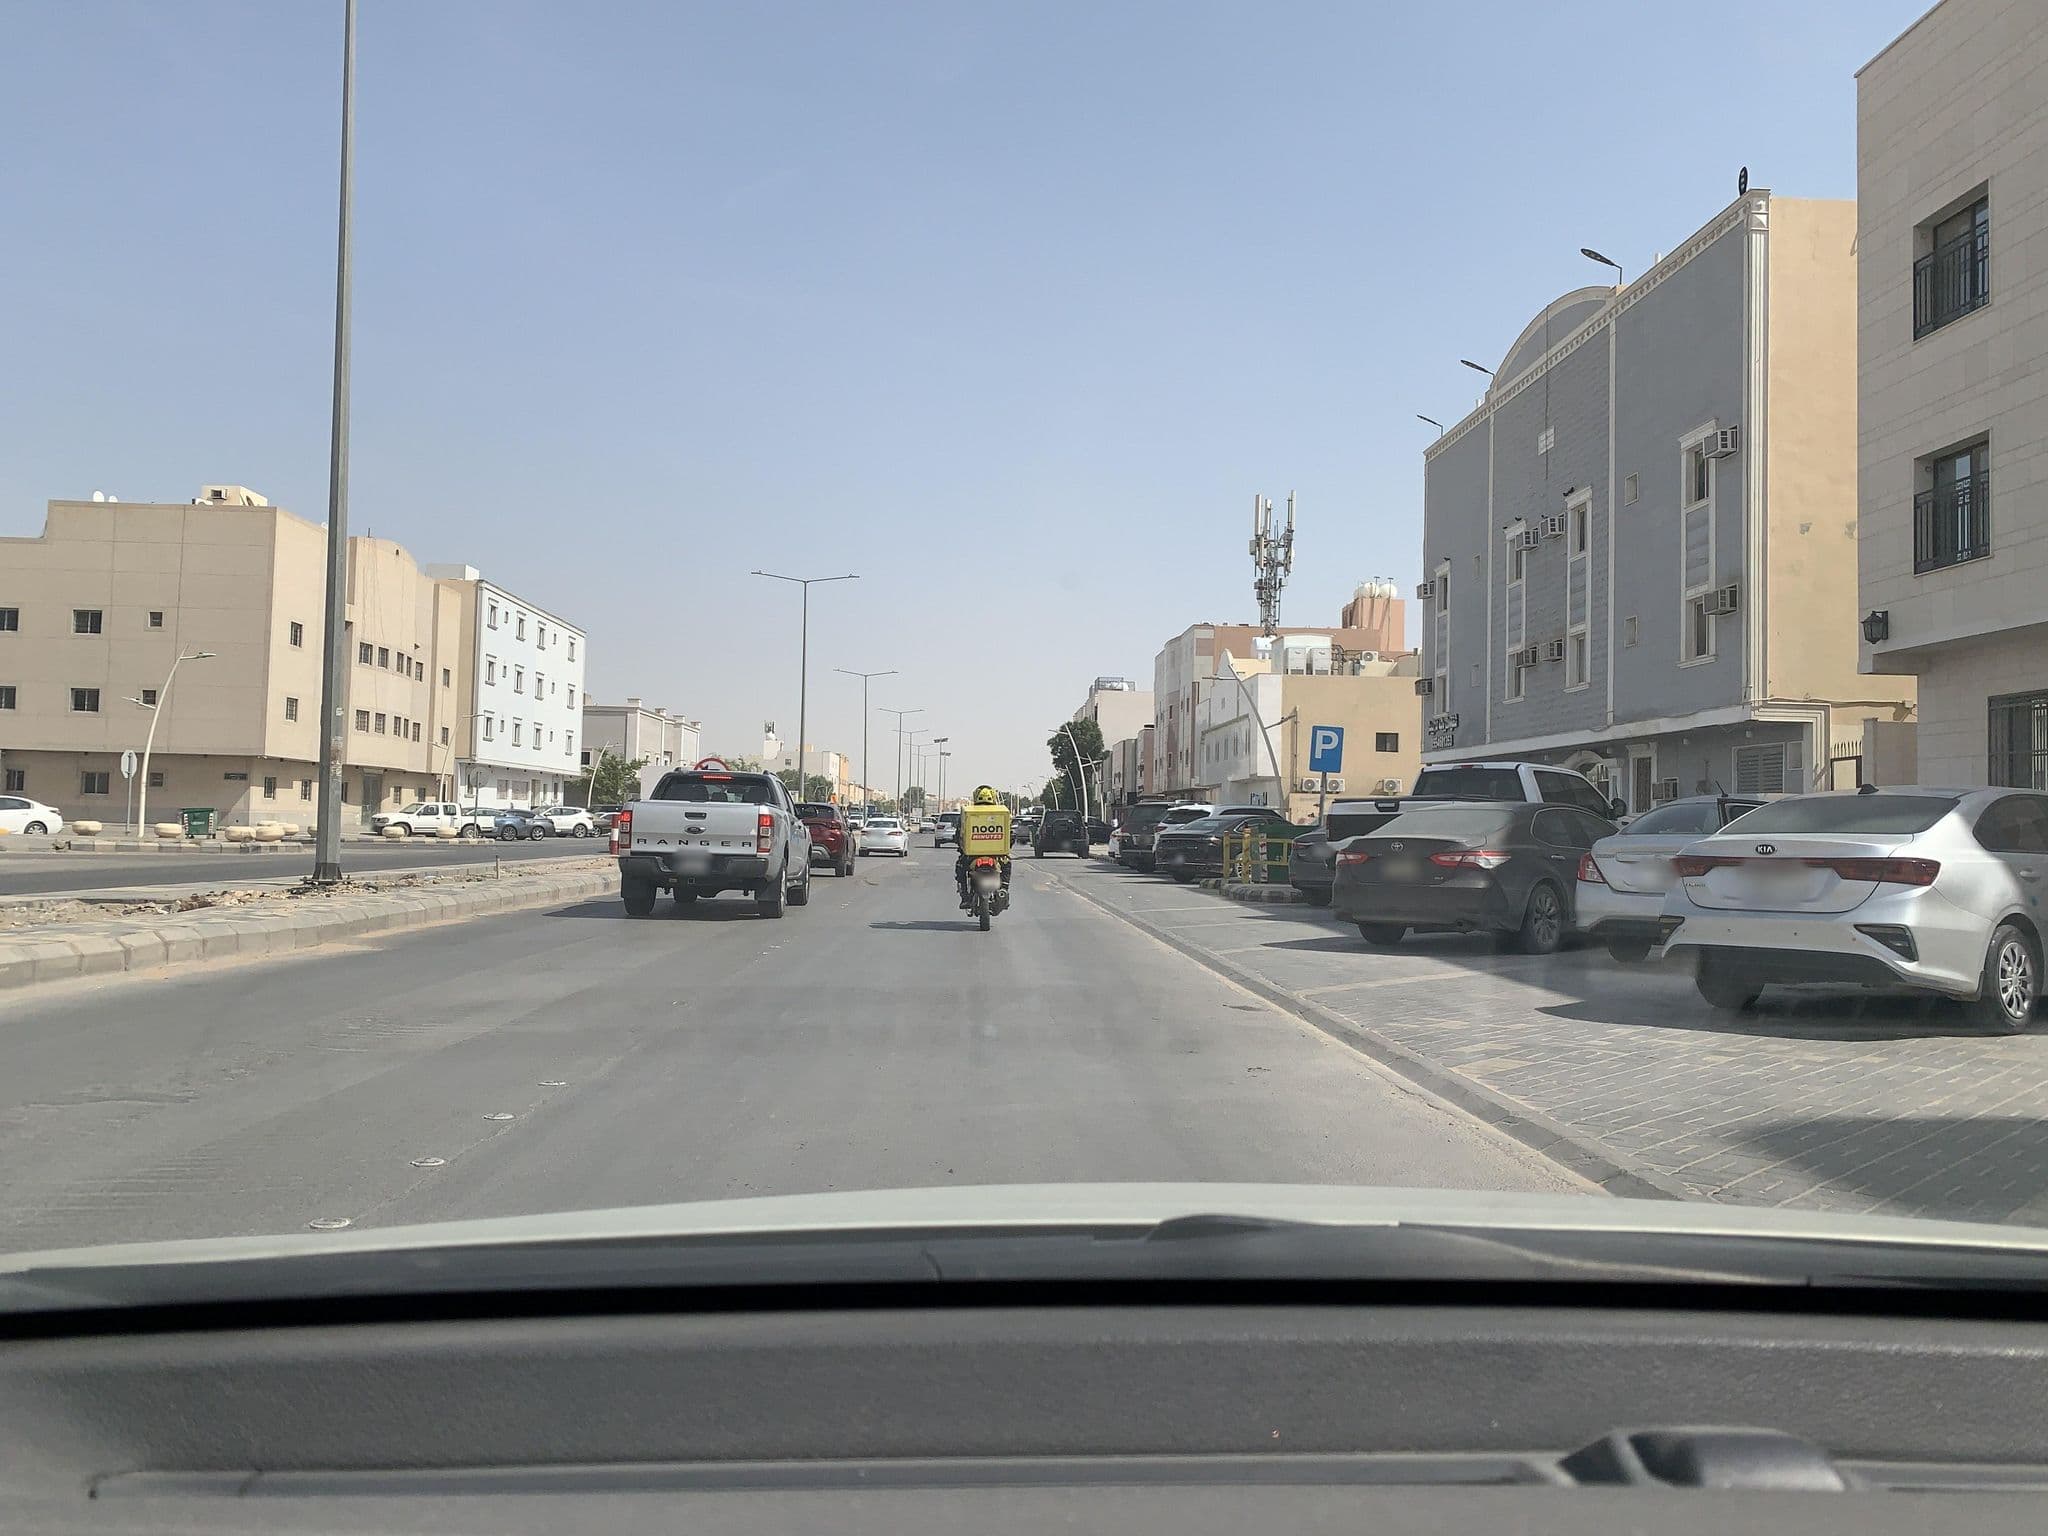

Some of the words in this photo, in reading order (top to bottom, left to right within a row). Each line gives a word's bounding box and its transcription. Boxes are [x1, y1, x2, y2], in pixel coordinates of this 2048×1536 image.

[1315, 730, 1339, 759] P
[972, 825, 1003, 833] noon
[637, 838, 752, 847] RANGER
[1757, 845, 1773, 853] KIA
